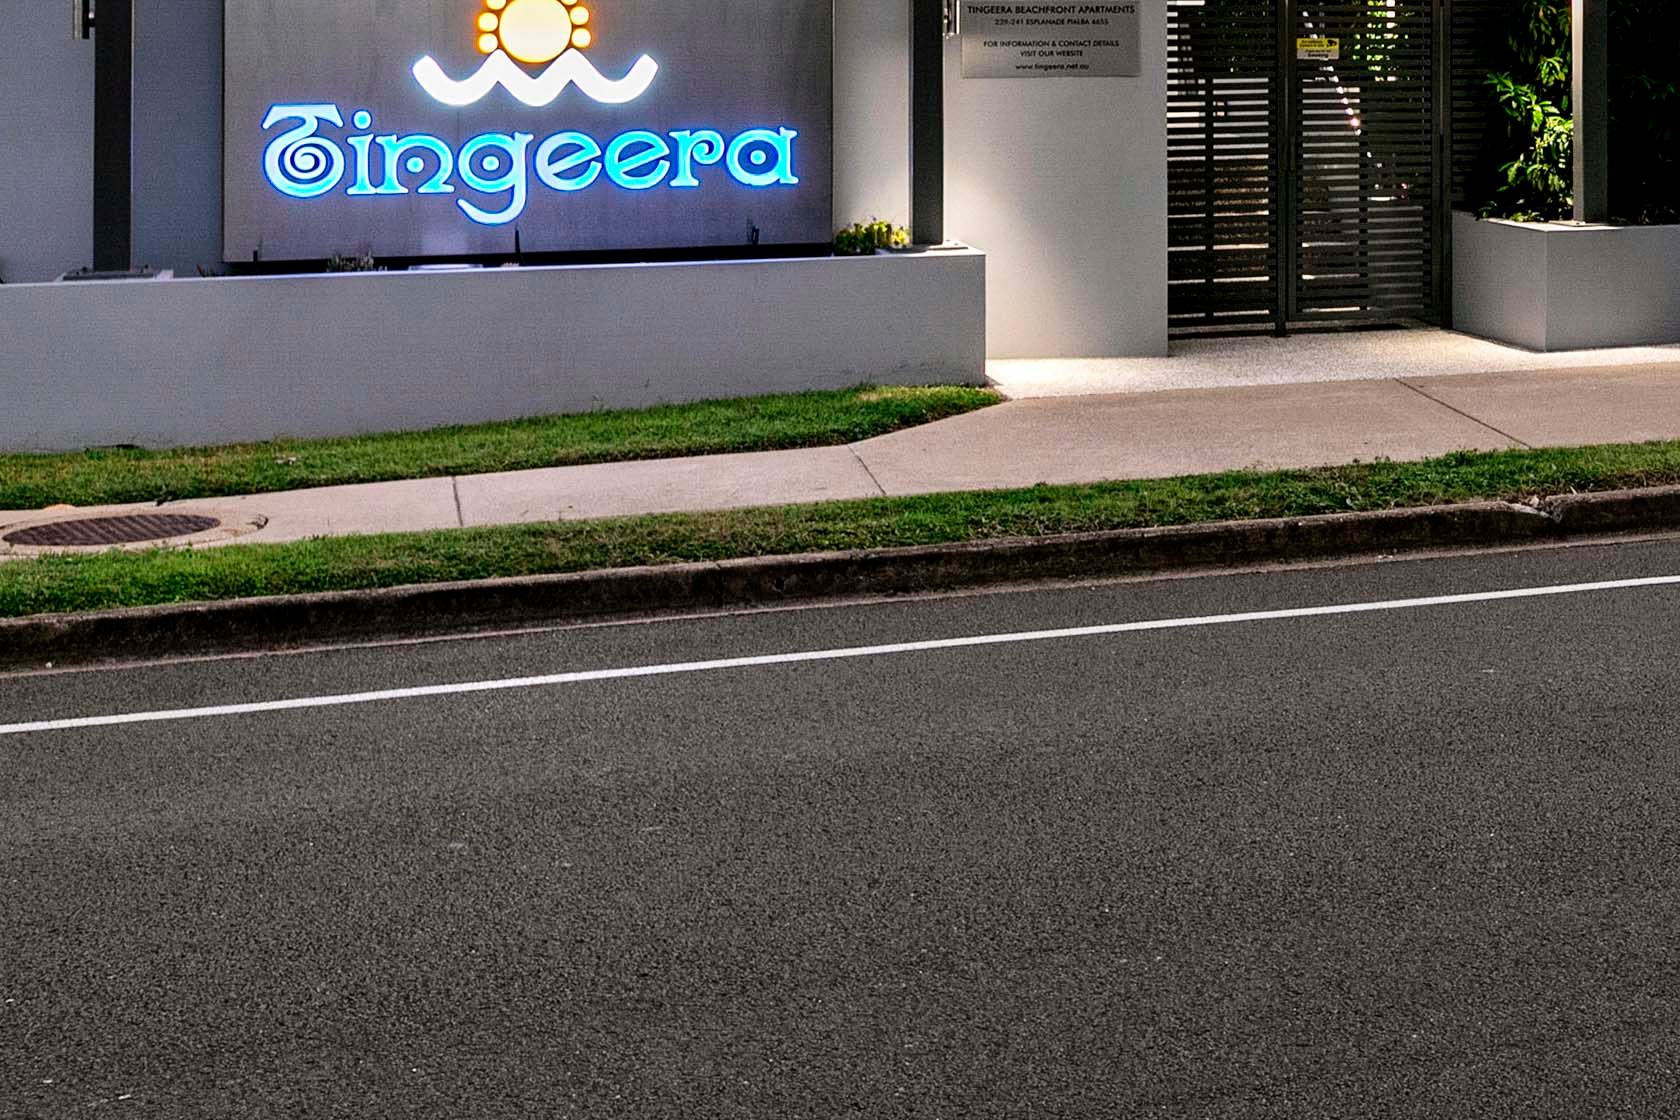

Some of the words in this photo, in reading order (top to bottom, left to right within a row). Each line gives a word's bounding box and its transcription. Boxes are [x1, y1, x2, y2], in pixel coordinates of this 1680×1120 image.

[968, 6, 1013, 14] TINGEERA
[1015, 6, 1075, 14] BEACHFRONT
[1078, 6, 1135, 14] APARTMENTS
[261, 102, 800, 226] Tingeera
